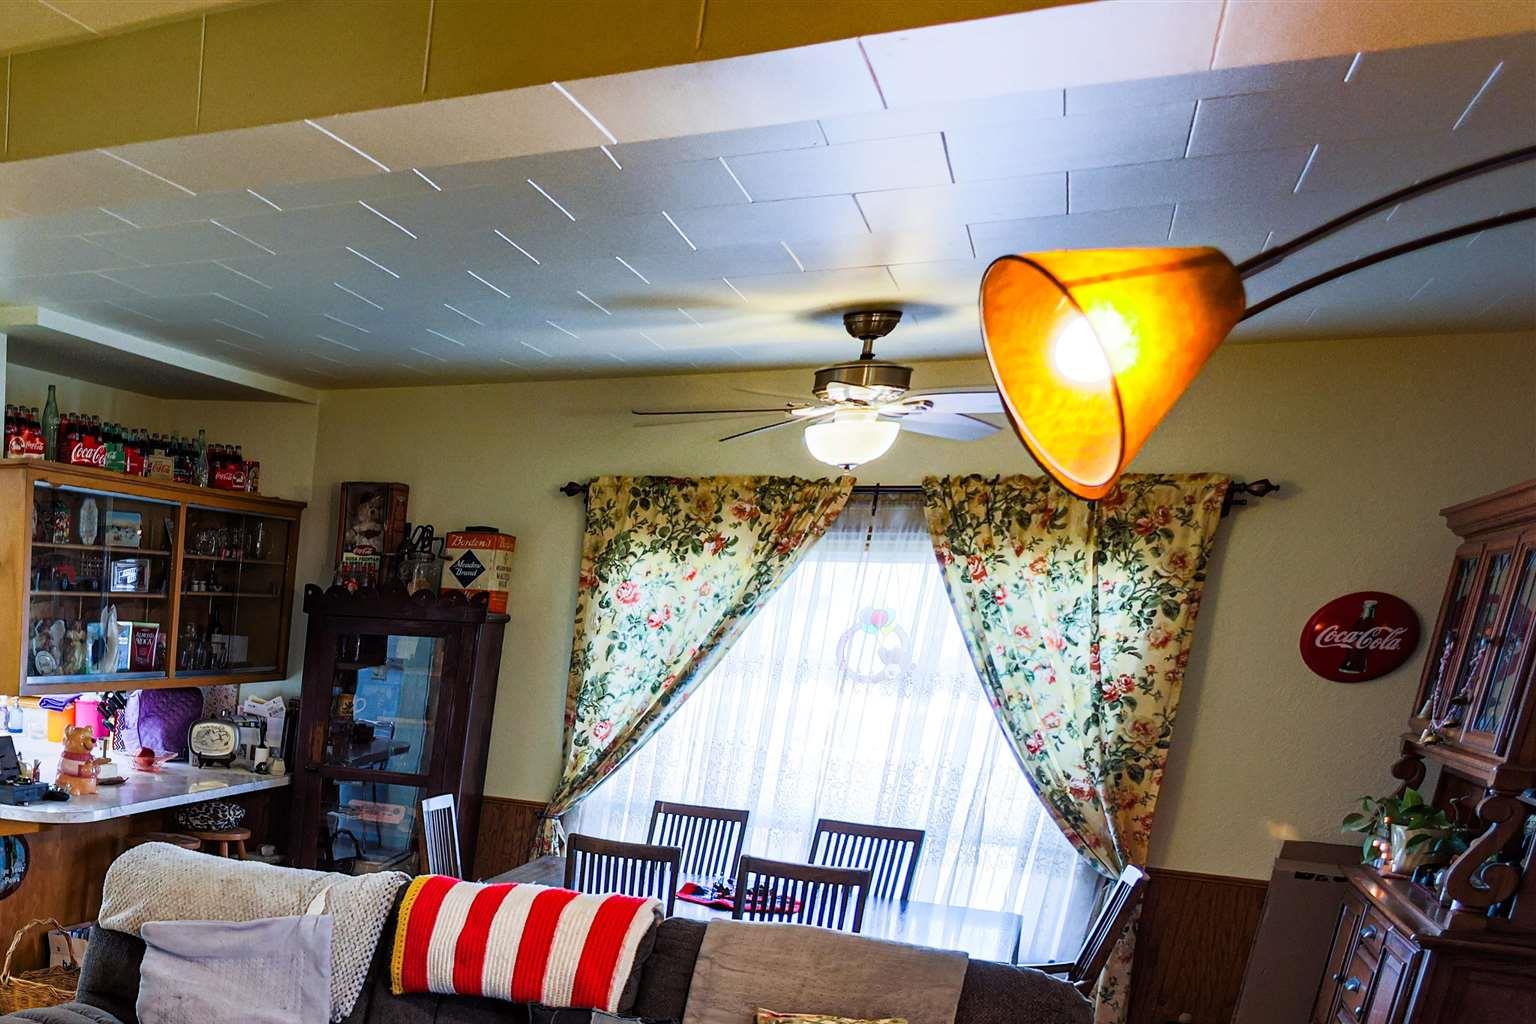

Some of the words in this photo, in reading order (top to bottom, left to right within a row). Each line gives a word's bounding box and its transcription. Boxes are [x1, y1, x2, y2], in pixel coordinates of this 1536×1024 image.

[71, 442, 107, 466] Coca-Co
[451, 534, 491, 547] Borden's
[455, 567, 478, 577] Brand
[1315, 625, 1408, 650] Coca-Cola
